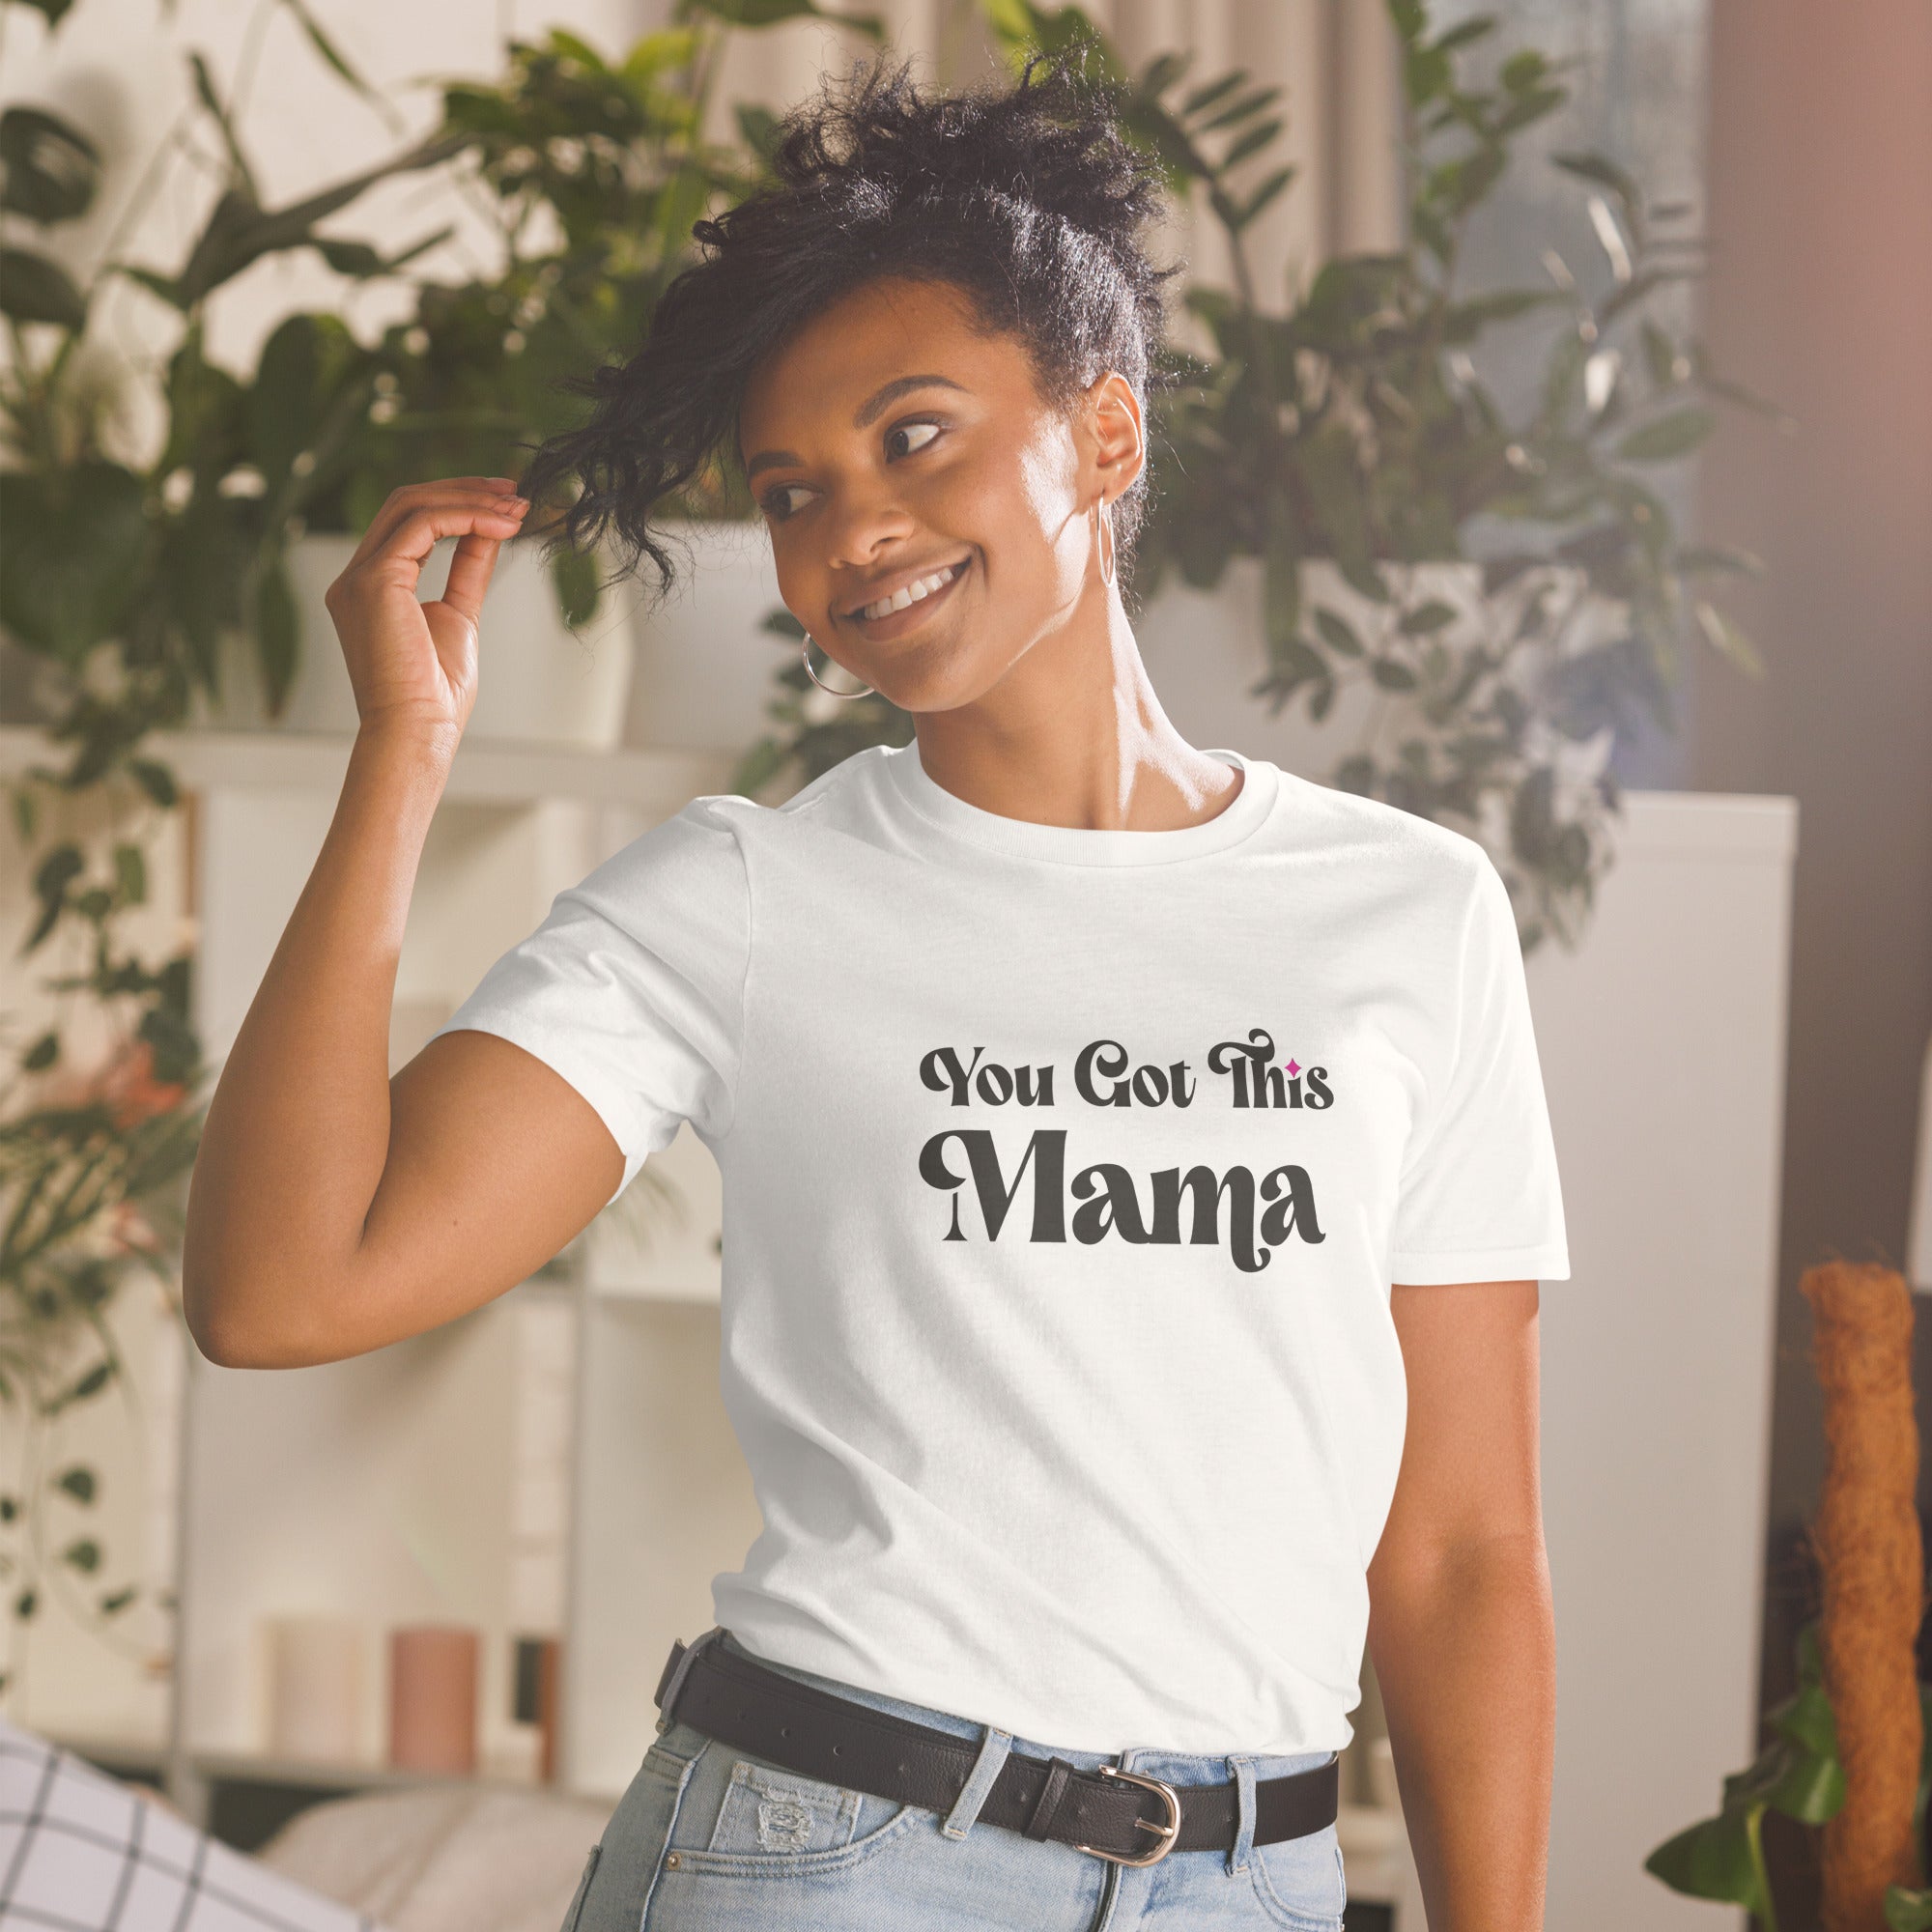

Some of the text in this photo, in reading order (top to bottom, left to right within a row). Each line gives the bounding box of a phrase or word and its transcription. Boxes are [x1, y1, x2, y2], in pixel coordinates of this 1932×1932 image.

[919, 1028, 1335, 1110] You Got This
[918, 1129, 1326, 1273] Mama
